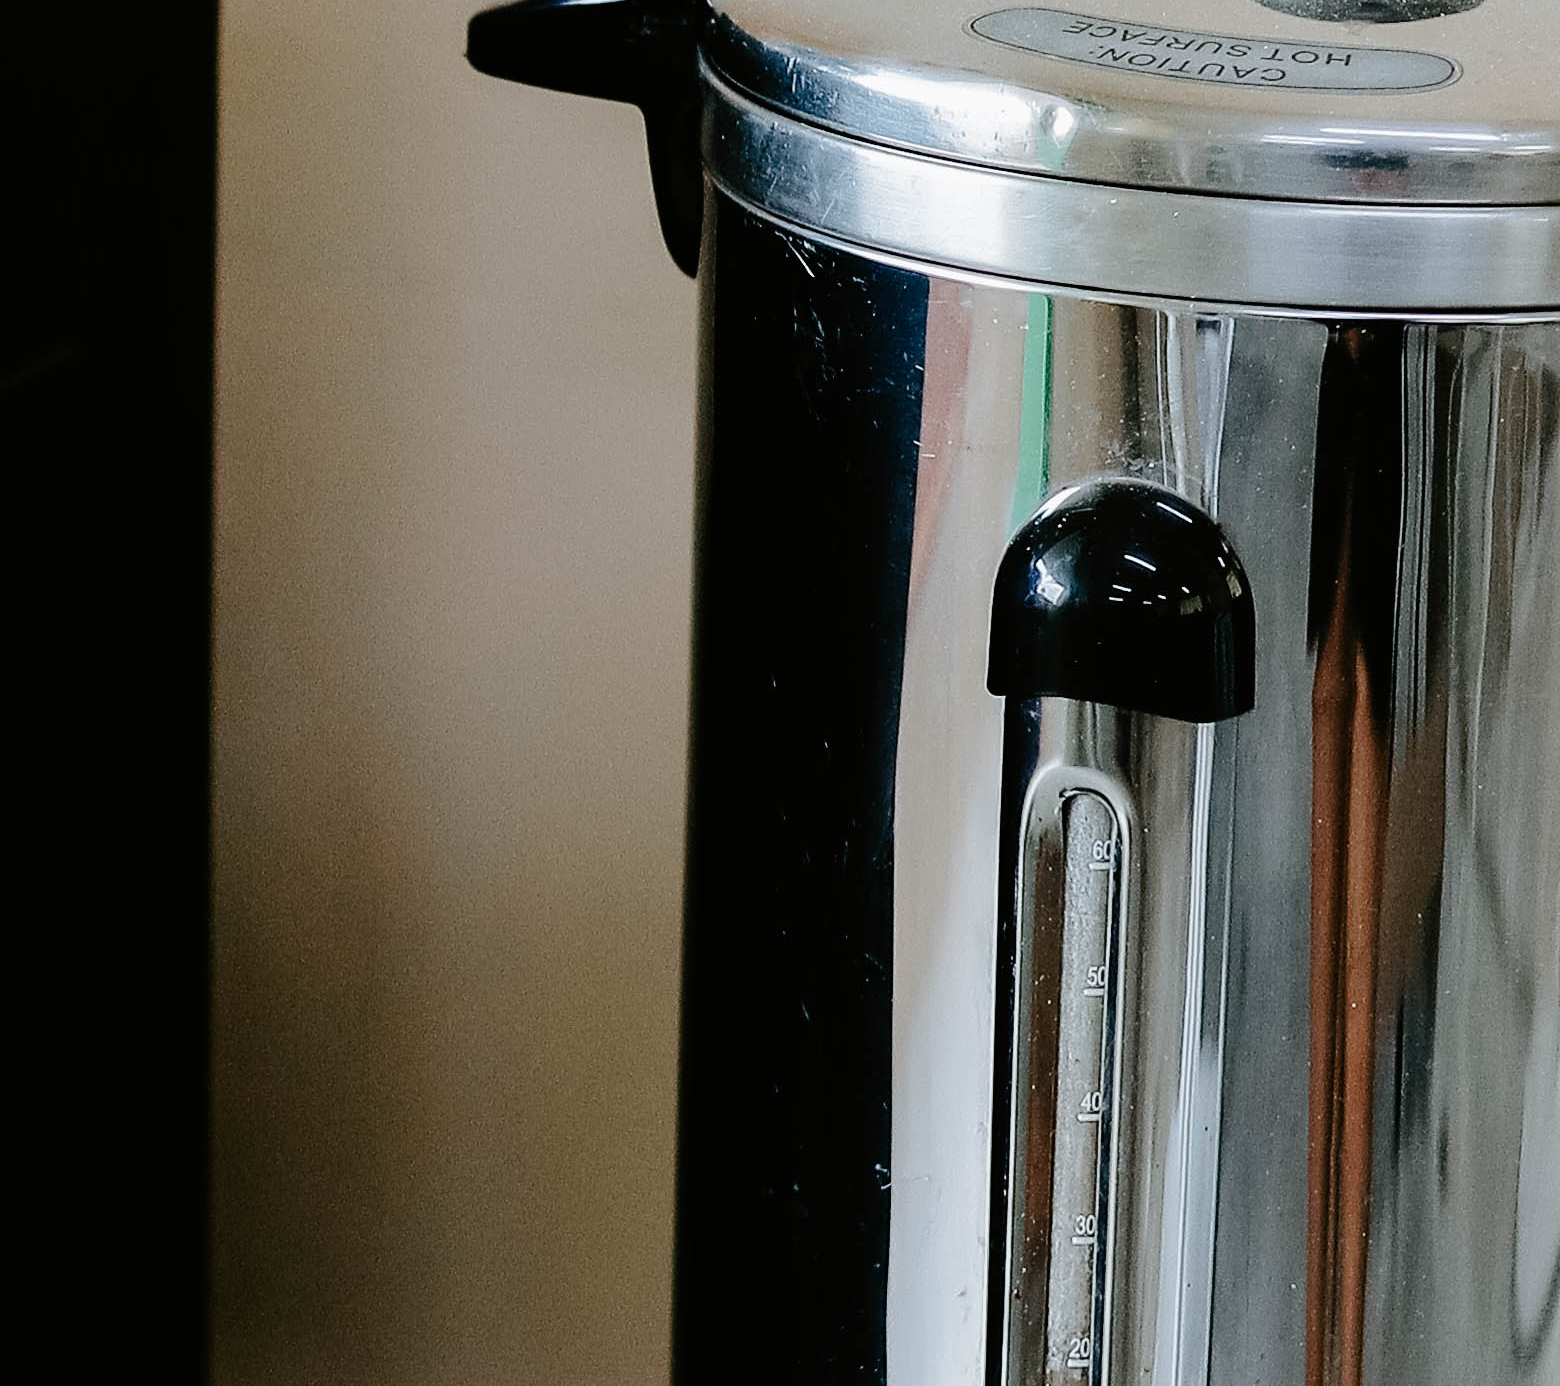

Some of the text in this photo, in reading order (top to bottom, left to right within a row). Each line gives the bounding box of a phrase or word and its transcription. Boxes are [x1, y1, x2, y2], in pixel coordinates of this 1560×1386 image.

[1062, 20, 1353, 67] HOT SURFACE
[1088, 46, 1287, 83] CAUTION:
[1091, 839, 1113, 861] 60
[1086, 965, 1107, 987] 50
[1080, 1091, 1103, 1112] 40
[1075, 1214, 1097, 1236] 30
[1068, 1337, 1091, 1359] 20
